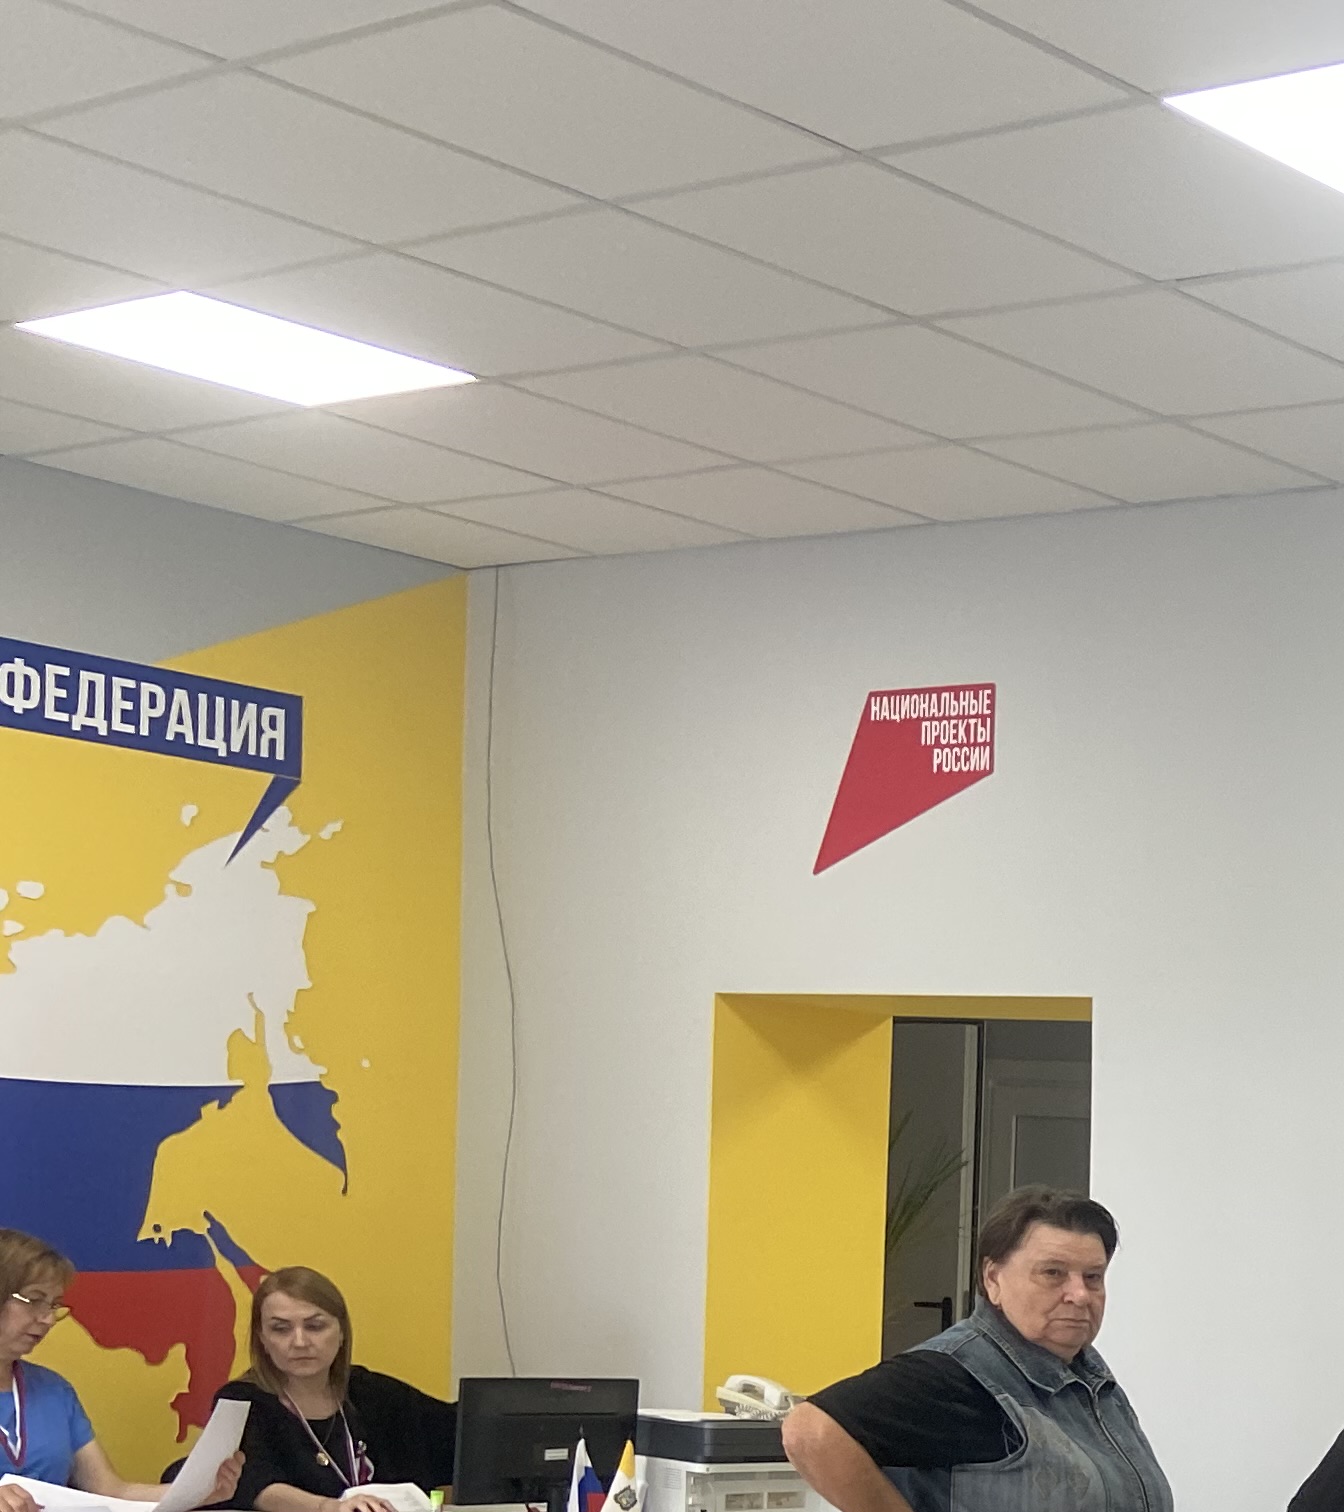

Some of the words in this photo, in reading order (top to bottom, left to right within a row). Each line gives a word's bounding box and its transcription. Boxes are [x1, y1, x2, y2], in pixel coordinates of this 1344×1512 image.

[0, 657, 286, 761] ФЕДЕРАЦИЯ
[870, 690, 992, 722] НАЦИОНАЛЬНЫЕ
[921, 718, 991, 746] ПРОЕКТЫ
[933, 747, 990, 774] РОССИИ
